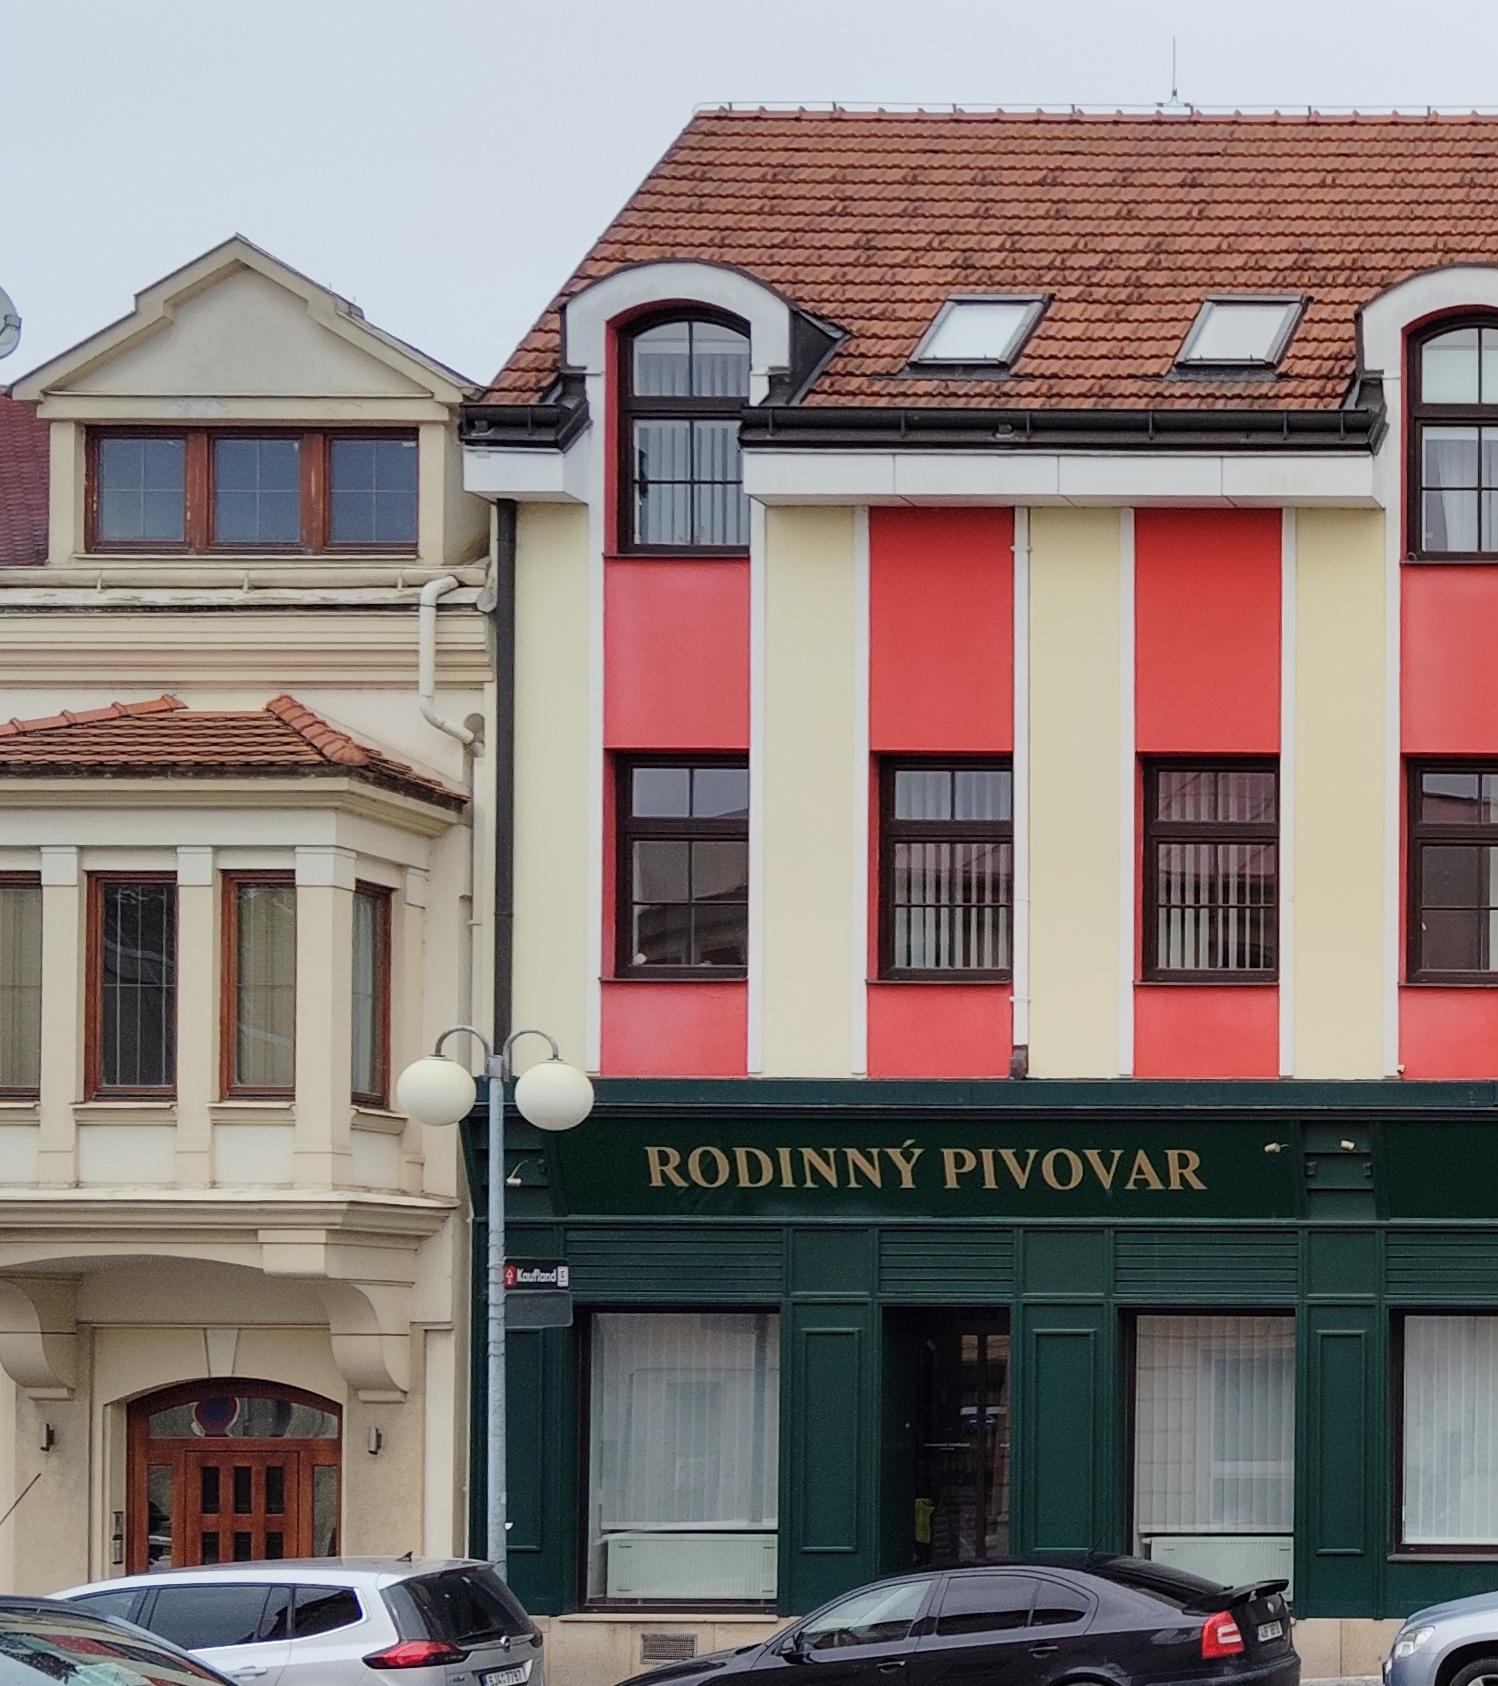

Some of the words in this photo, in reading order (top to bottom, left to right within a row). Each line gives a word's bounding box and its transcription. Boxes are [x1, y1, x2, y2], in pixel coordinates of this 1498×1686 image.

[644, 1138, 926, 1189] RODINNÝ
[940, 1147, 1208, 1191] PIVOVAR
[516, 1267, 557, 1284] Kaufland
